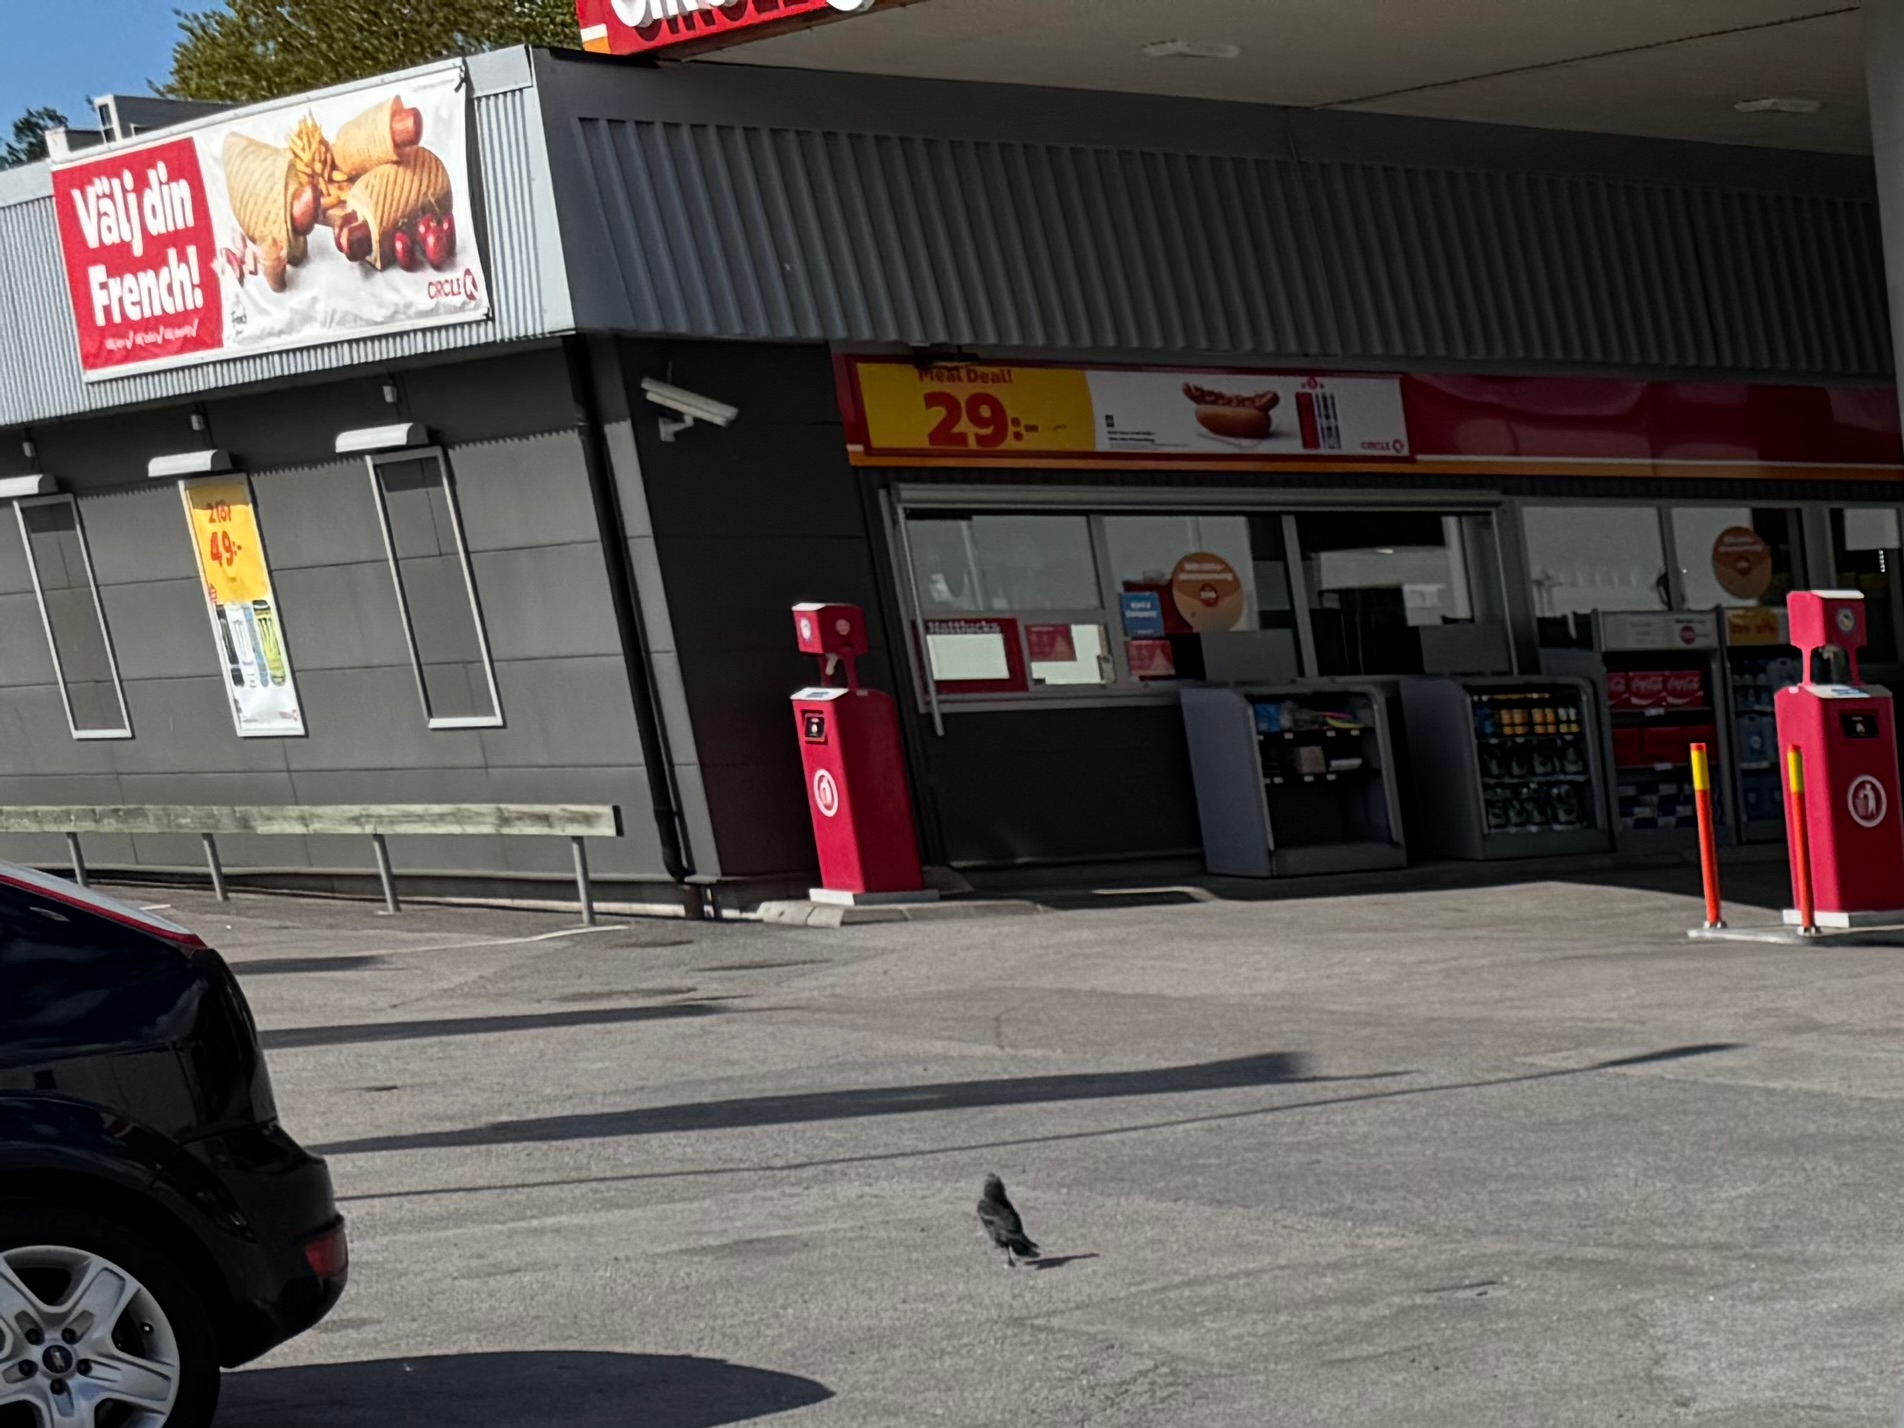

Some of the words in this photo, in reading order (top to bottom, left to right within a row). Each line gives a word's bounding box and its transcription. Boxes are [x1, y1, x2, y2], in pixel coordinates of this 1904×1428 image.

[71, 168, 143, 257] Välj
[143, 161, 194, 236] din
[88, 245, 203, 327] French!
[966, 368, 1014, 384] Deal!
